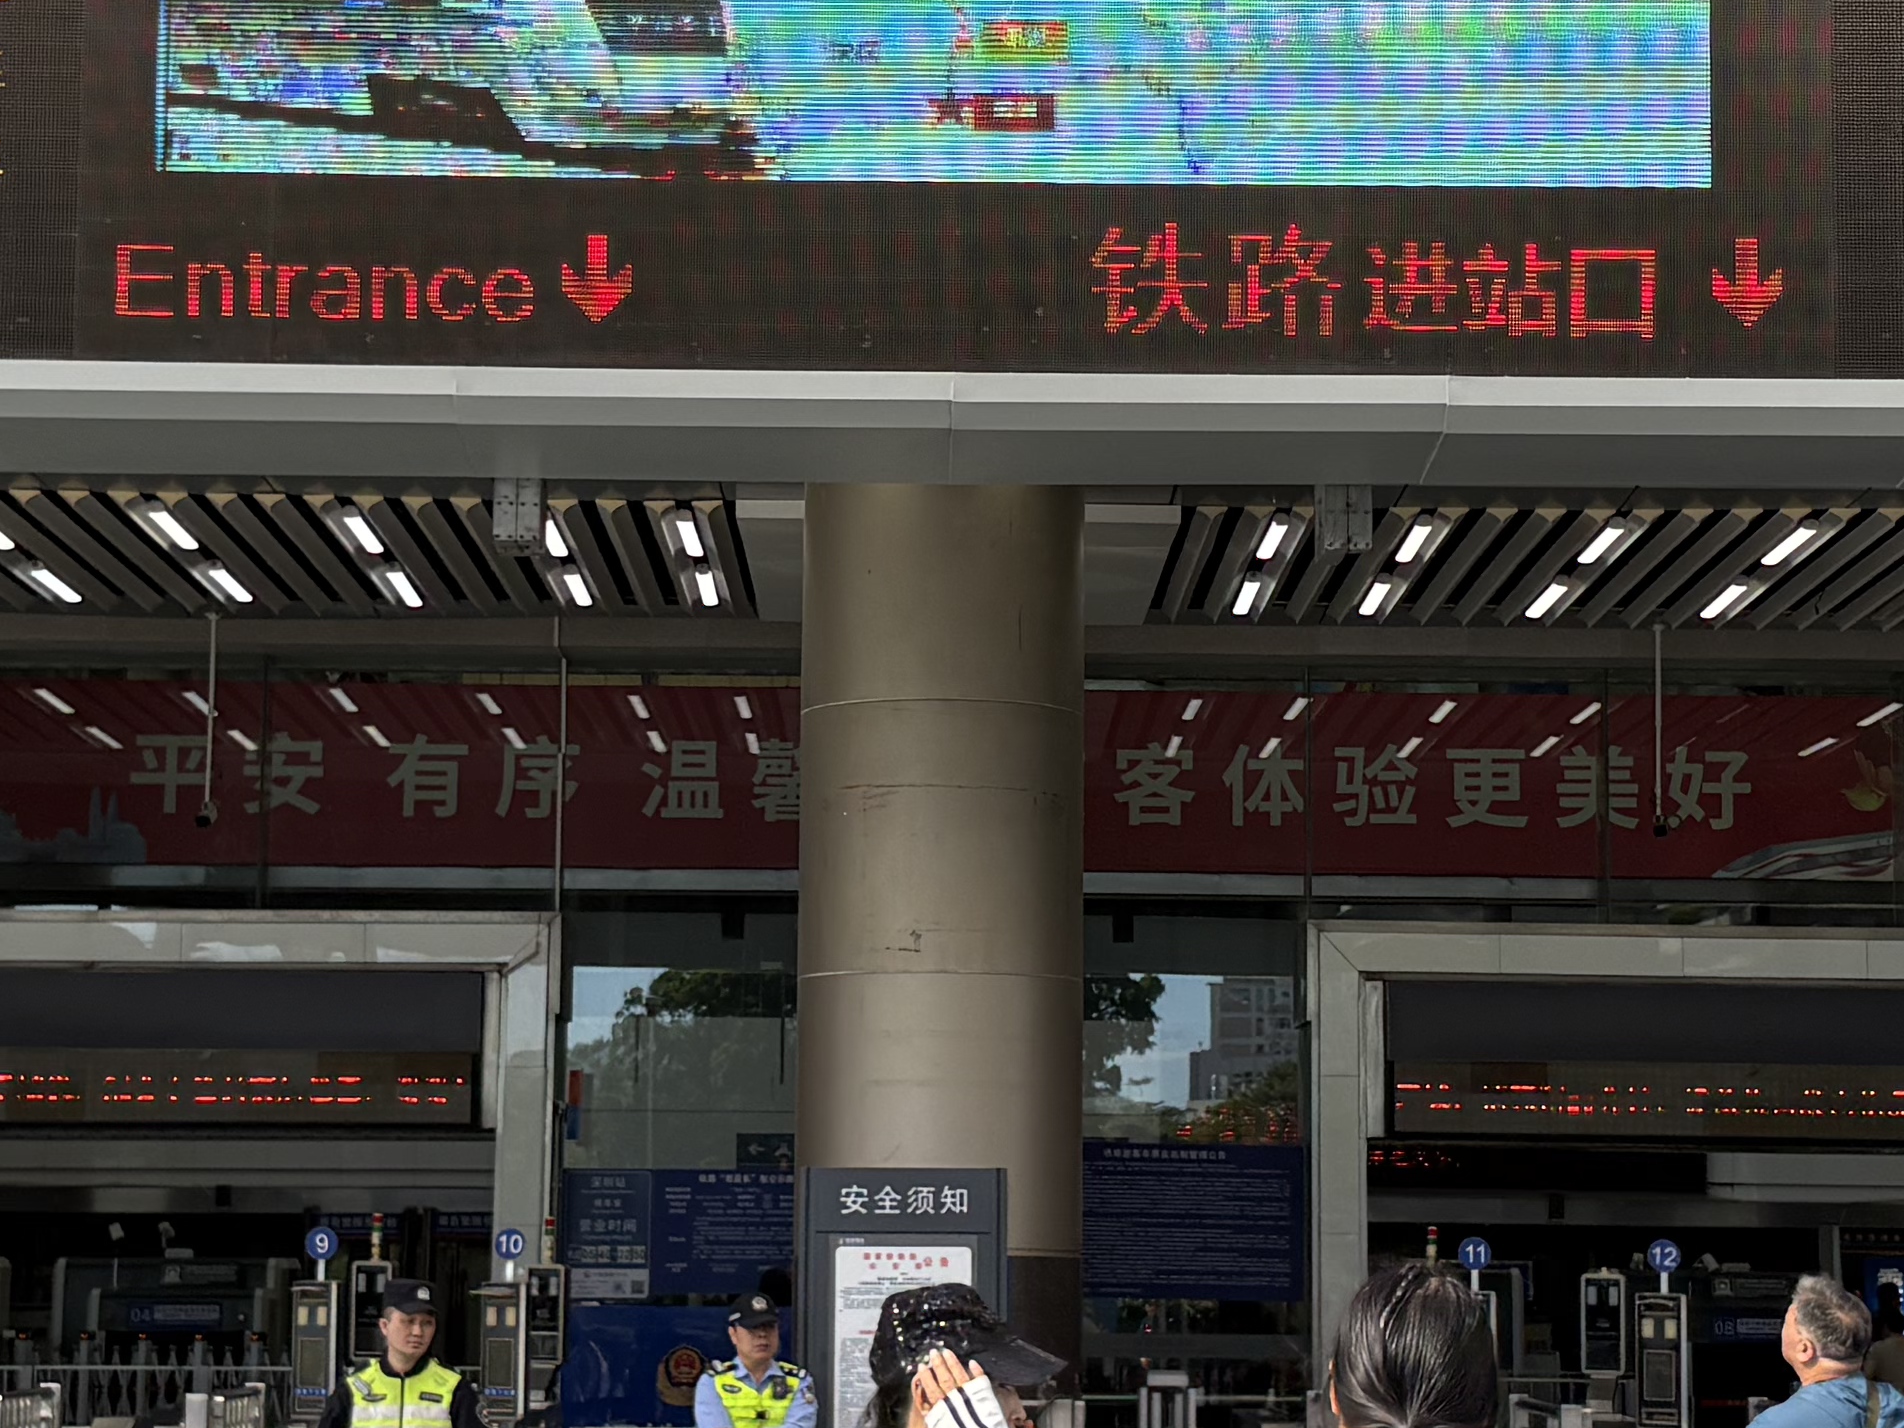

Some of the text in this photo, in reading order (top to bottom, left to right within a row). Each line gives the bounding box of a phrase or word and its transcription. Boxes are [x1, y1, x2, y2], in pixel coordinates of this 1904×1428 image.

[116, 244, 534, 323] Entrance
[1089, 222, 1658, 340] 铁路进站口
[840, 1184, 968, 1214] 安全须知
[315, 1233, 329, 1254] 9
[498, 1234, 523, 1254] 10
[1465, 1244, 1485, 1263] 11
[1652, 1246, 1677, 1266] 12
